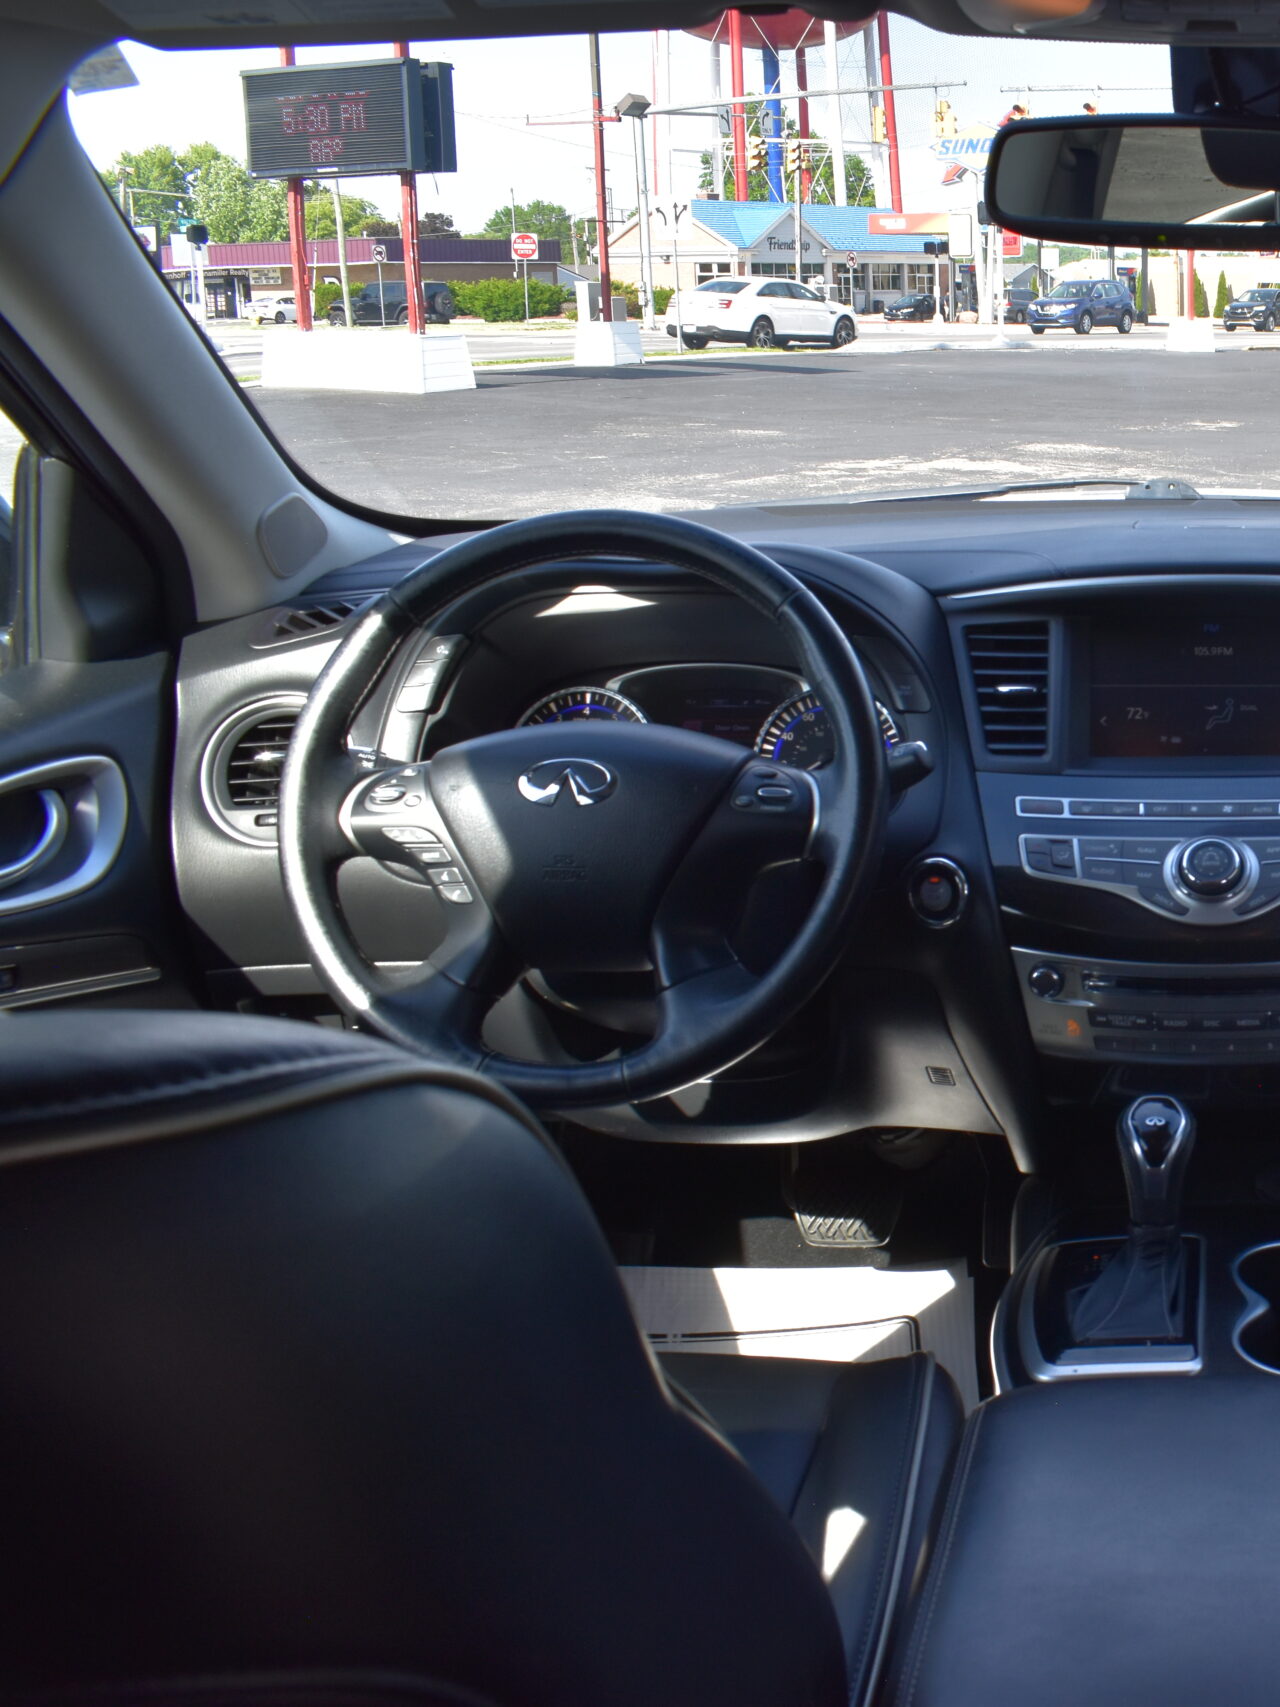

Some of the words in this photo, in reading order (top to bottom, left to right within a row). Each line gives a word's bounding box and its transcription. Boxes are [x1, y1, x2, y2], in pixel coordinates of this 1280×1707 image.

[282, 105, 329, 134] 5:30
[340, 103, 366, 130] PM
[938, 137, 994, 155] SUNO
[766, 236, 811, 253] Friendip
[230, 268, 249, 277] Realty
[583, 706, 590, 716] 4
[781, 732, 794, 741] 40
[1163, 1019, 1188, 1027] RADIO
